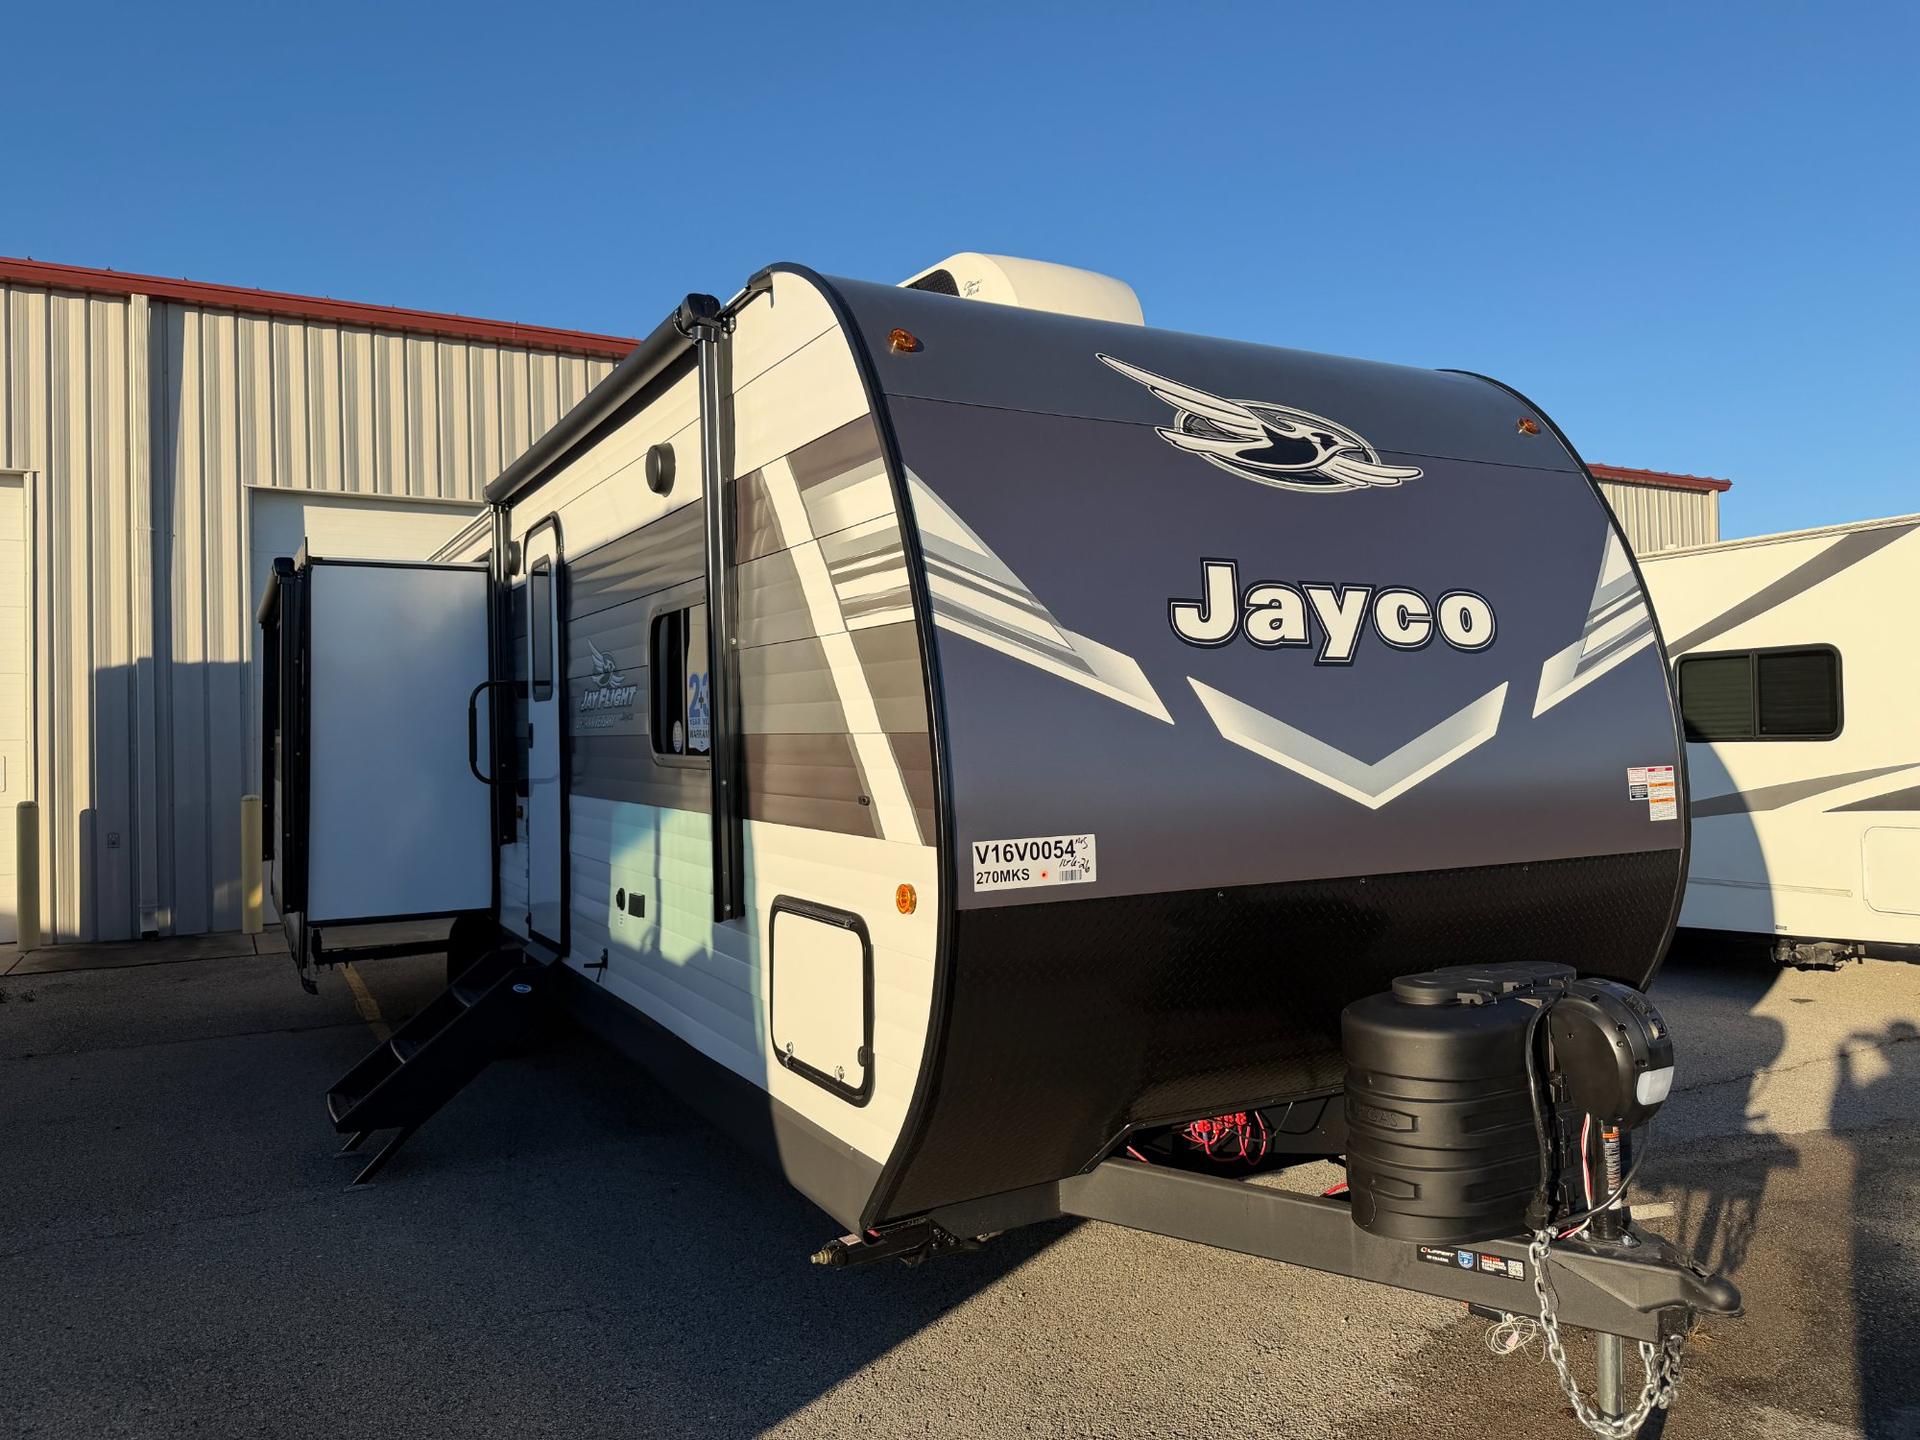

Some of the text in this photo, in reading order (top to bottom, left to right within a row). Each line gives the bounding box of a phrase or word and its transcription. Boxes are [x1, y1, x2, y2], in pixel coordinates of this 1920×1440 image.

[1168, 557, 1496, 666] Jayco
[580, 686, 638, 711] JAY FLIGHT
[975, 839, 1076, 864] V16V0054
[976, 868, 1030, 884] 270MKS
